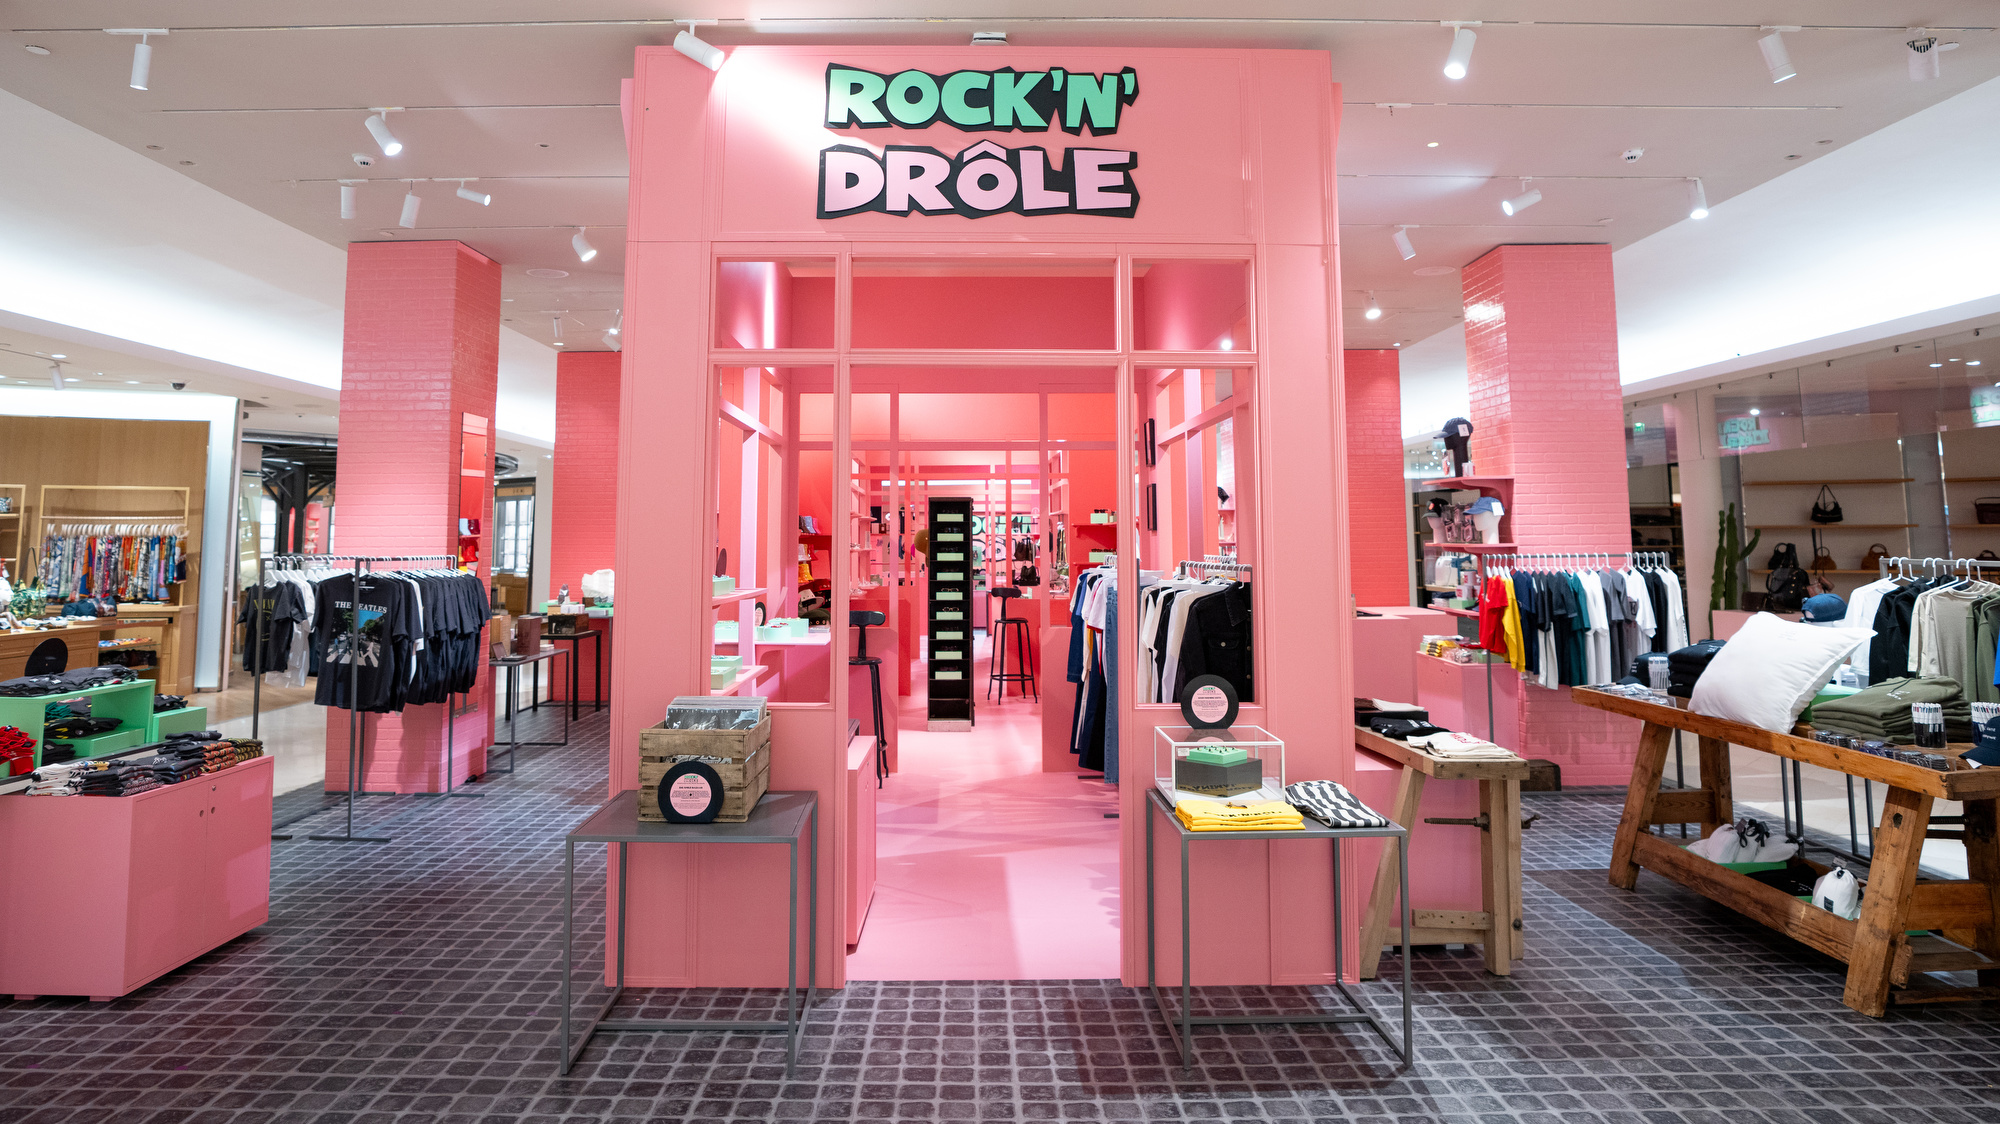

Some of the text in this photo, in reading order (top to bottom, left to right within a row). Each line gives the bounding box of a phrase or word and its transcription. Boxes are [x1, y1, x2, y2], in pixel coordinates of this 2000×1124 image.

[826, 66, 1138, 130] ROCK'N'
[823, 140, 1133, 213] DRÔLE
[334, 601, 388, 614] THE EATLES
